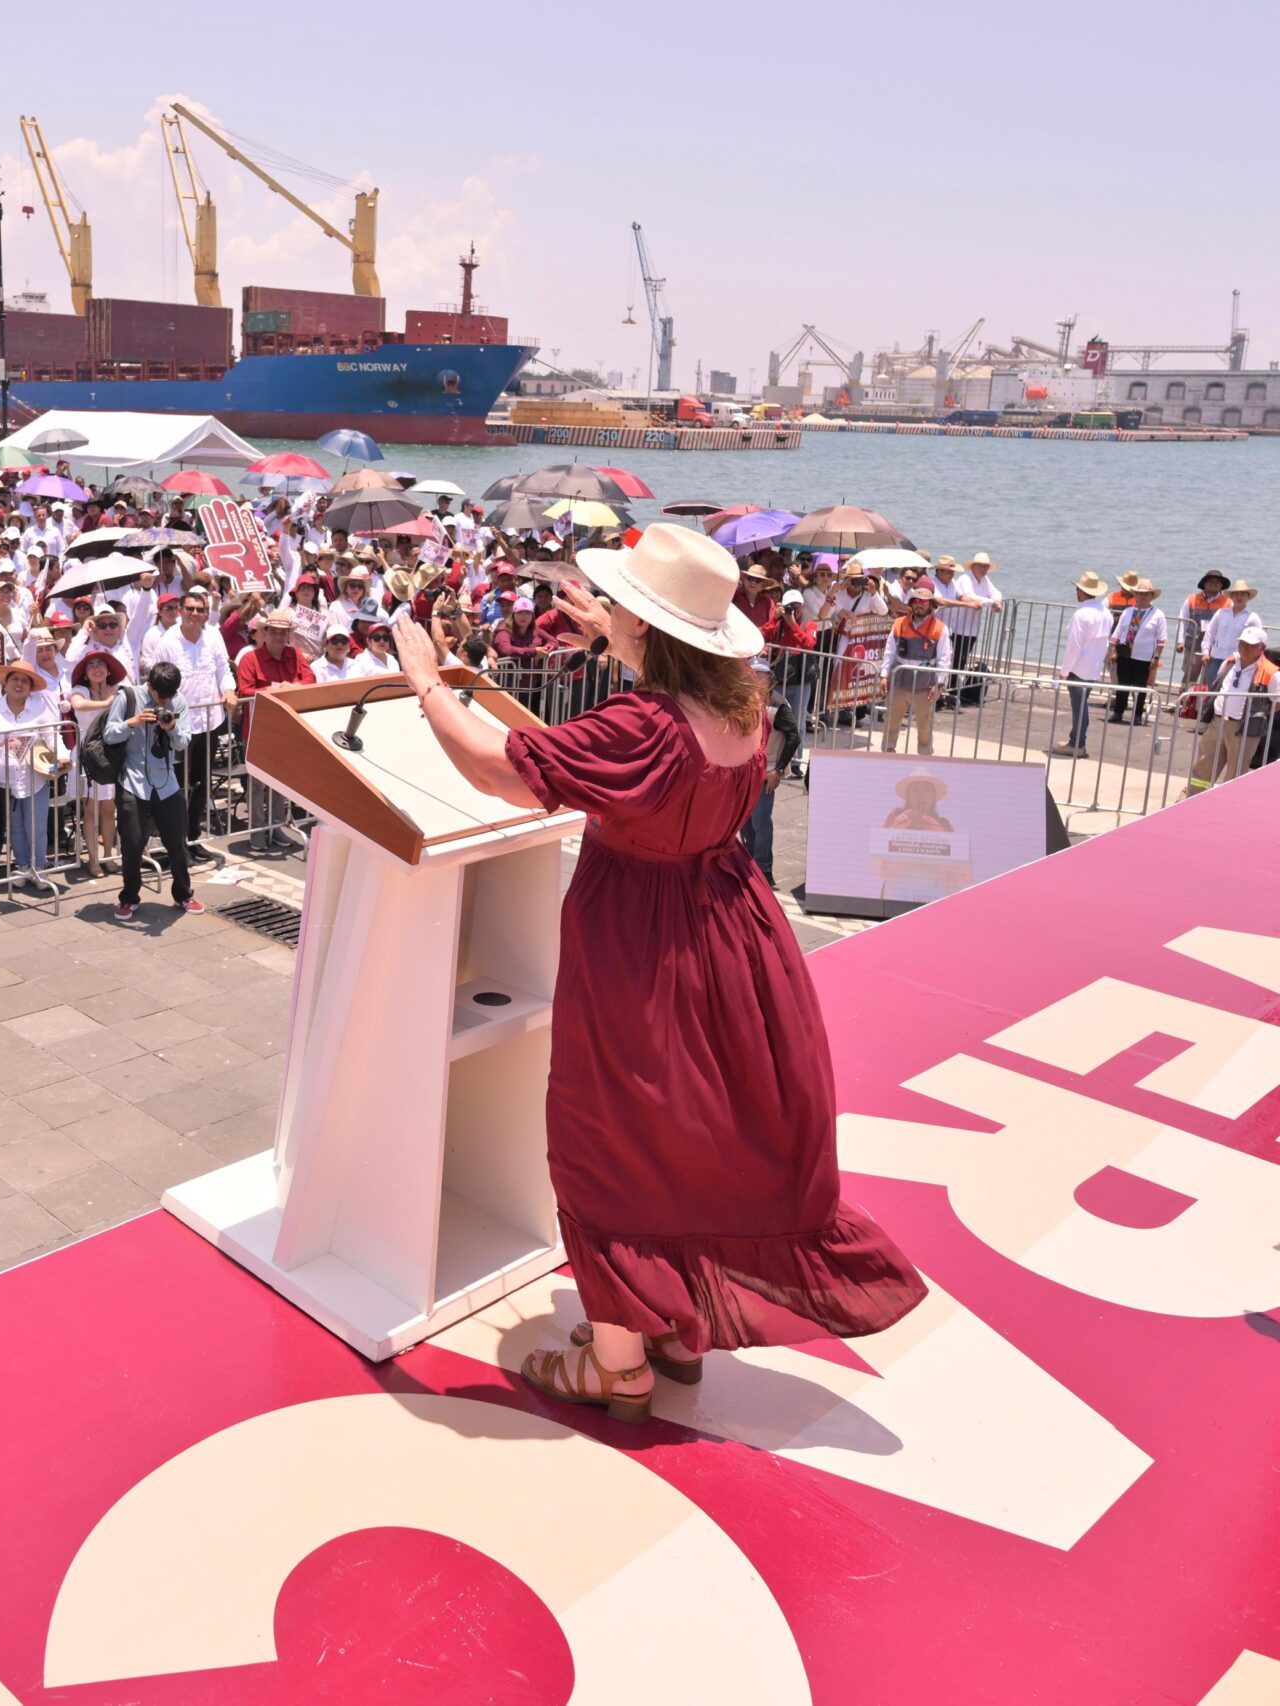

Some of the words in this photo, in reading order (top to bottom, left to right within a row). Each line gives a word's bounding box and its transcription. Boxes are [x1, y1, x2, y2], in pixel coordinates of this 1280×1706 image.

[337, 362, 357, 372] BBC
[359, 362, 408, 372] NORWAY
[550, 428, 569, 438] 200
[598, 430, 619, 440] 210
[645, 432, 665, 442] 220
[220, 519, 228, 528] EN
[230, 510, 245, 540] MARCHA
[241, 511, 255, 536] RICA
[252, 538, 267, 566] POZA
